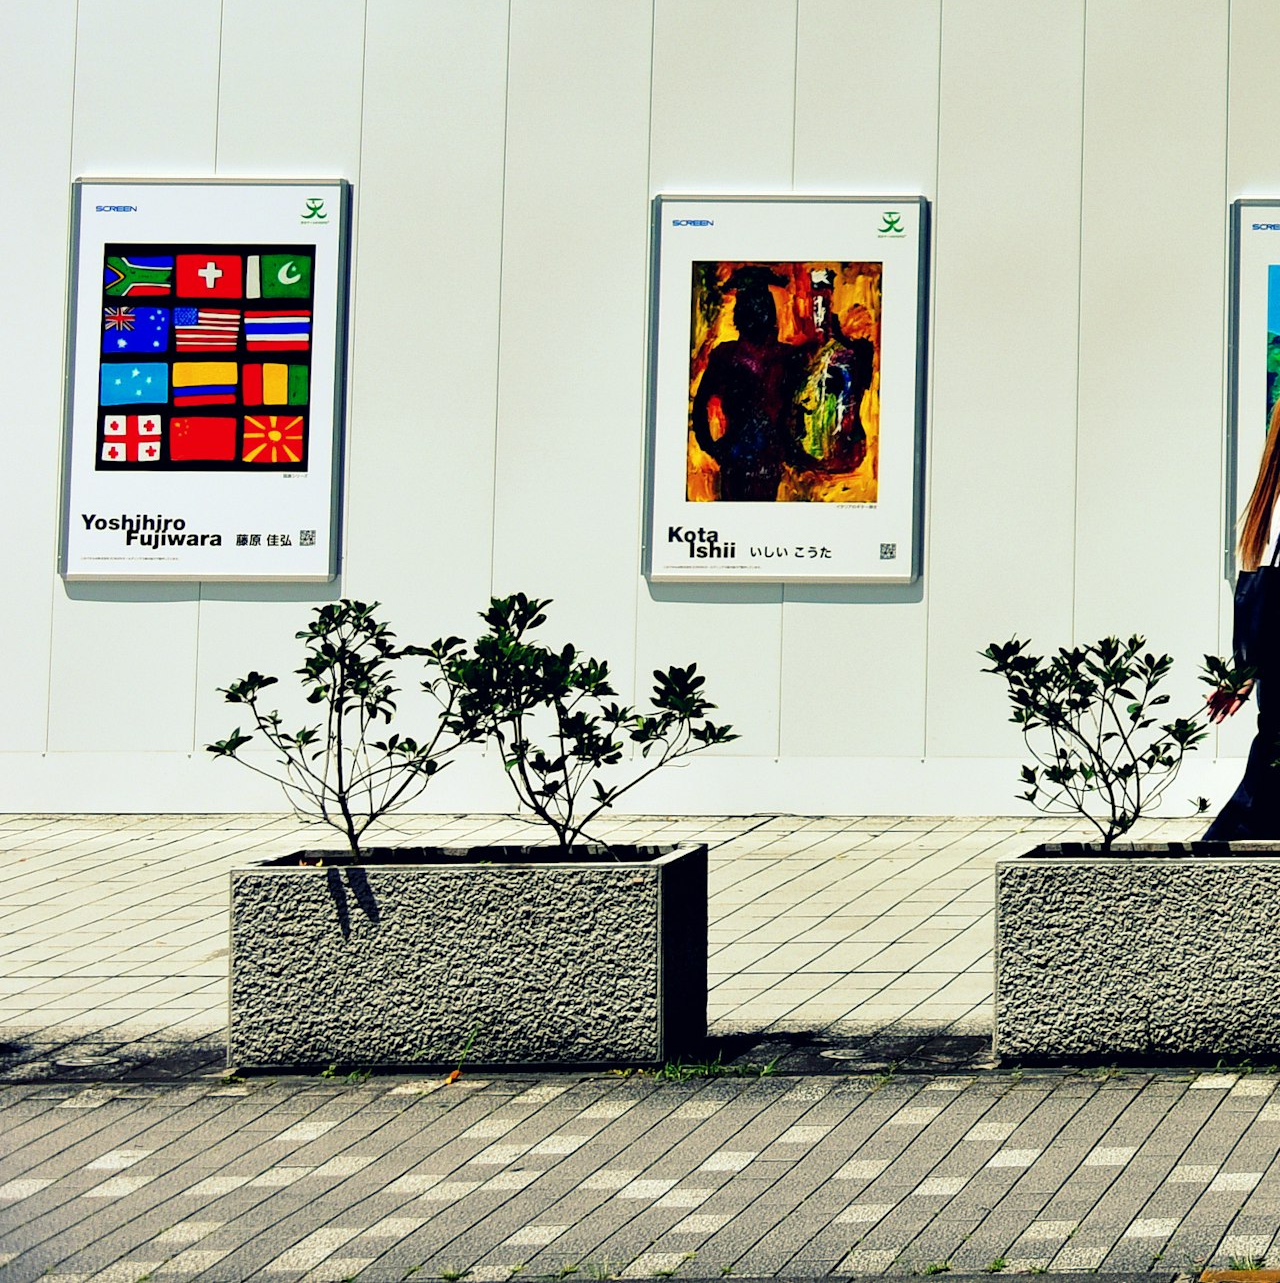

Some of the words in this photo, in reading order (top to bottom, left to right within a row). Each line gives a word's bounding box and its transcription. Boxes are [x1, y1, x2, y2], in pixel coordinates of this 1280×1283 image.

[672, 219, 714, 227] SCREEN
[81, 514, 186, 531] Yoshihiro
[126, 530, 222, 550] Fujiwara
[668, 526, 718, 543] Kota
[689, 542, 736, 559] Ishii
[750, 546, 788, 559] いしい
[794, 546, 832, 559] こうた
